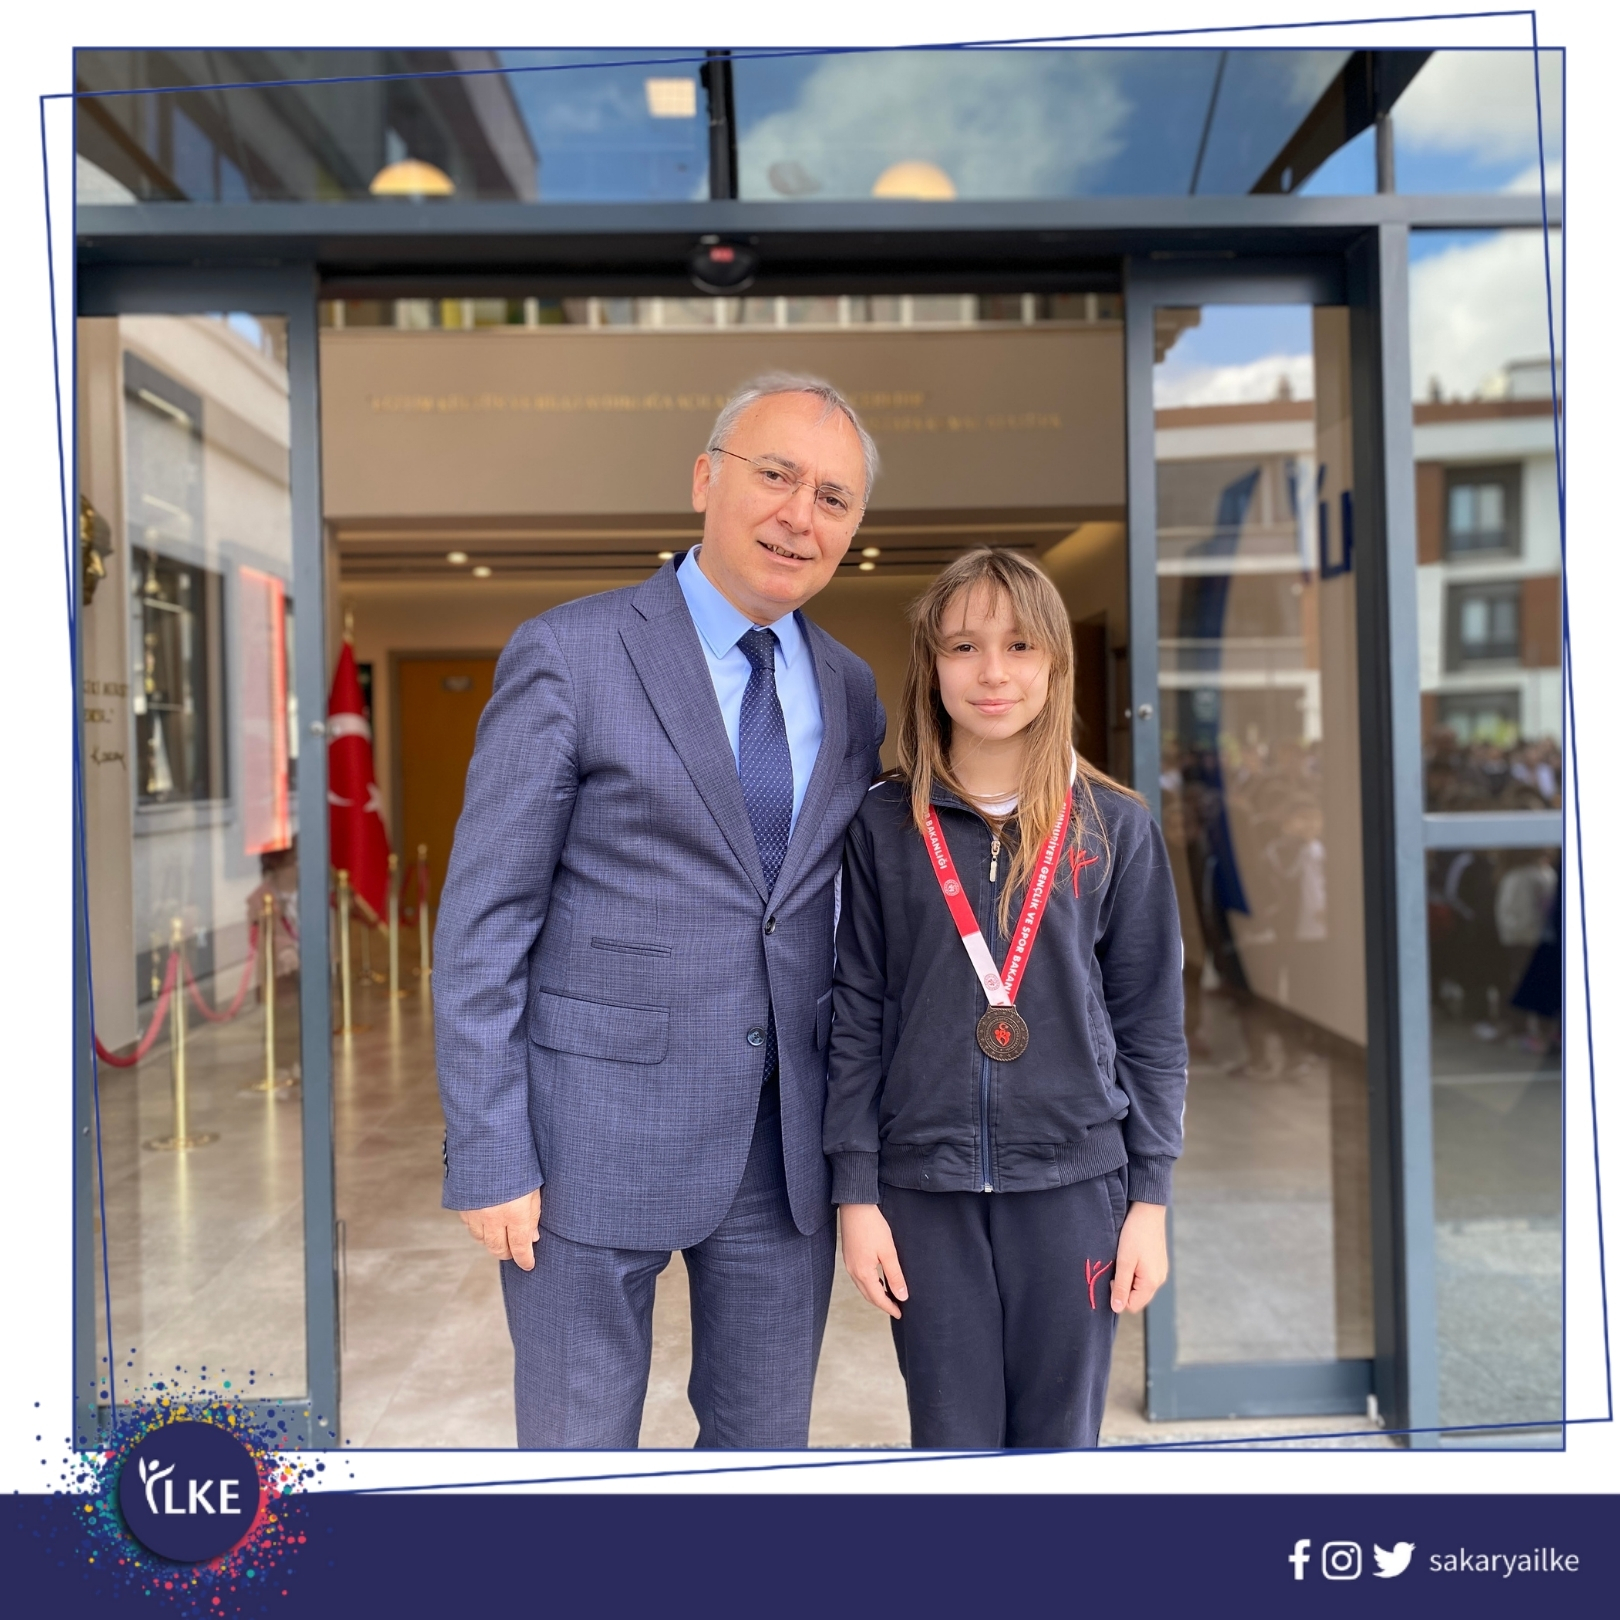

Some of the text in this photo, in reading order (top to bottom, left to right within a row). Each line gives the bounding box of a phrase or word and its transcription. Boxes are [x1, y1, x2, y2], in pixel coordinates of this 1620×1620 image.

[925, 819, 948, 870] BAKANLIĞI
[1029, 866, 1049, 910] GENÇLİK
[1025, 912, 1036, 925] VE
[1015, 926, 1031, 953] SPOR
[1004, 955, 1022, 995] BAKAN
